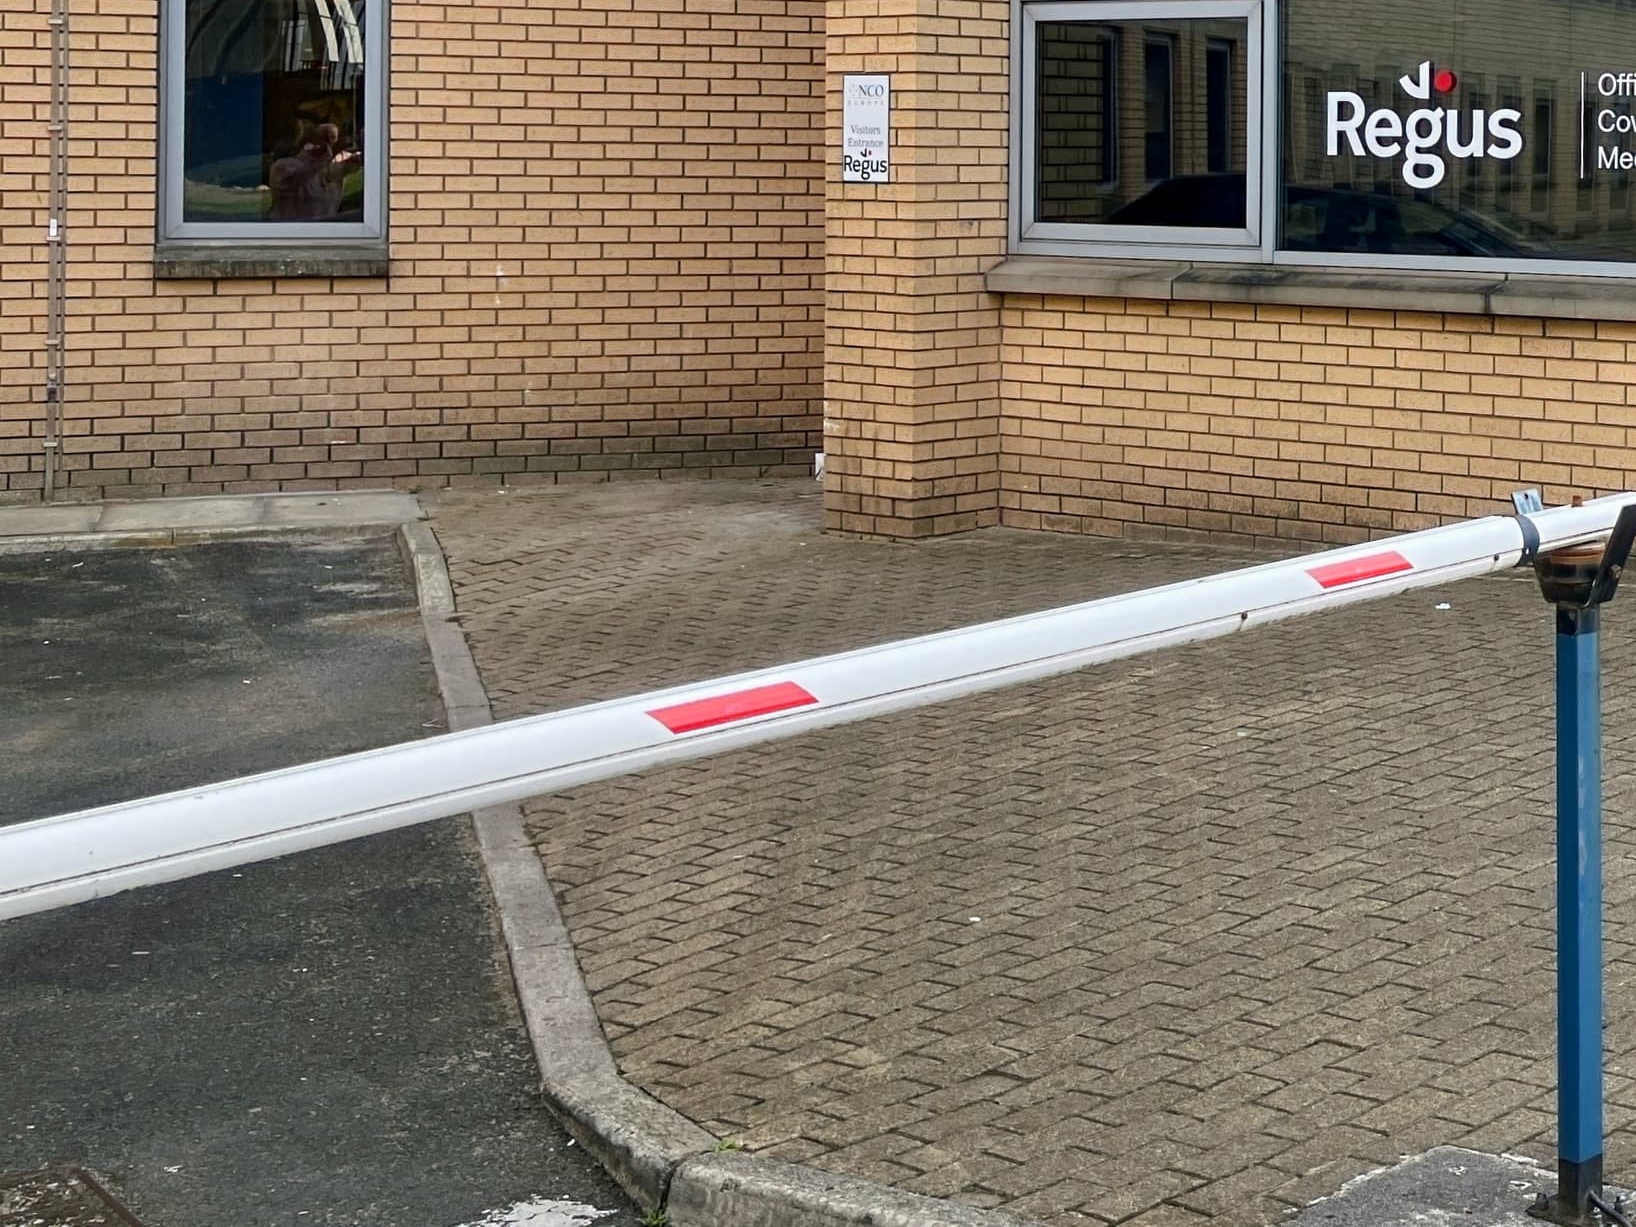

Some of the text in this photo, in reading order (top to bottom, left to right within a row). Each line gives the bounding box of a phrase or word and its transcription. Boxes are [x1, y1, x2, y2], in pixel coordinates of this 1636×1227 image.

[858, 84, 884, 97] NCO
[850, 124, 881, 135] Visitors
[847, 137, 884, 148] Entrance
[1326, 90, 1524, 190] Regus
[844, 155, 887, 180] Regus
